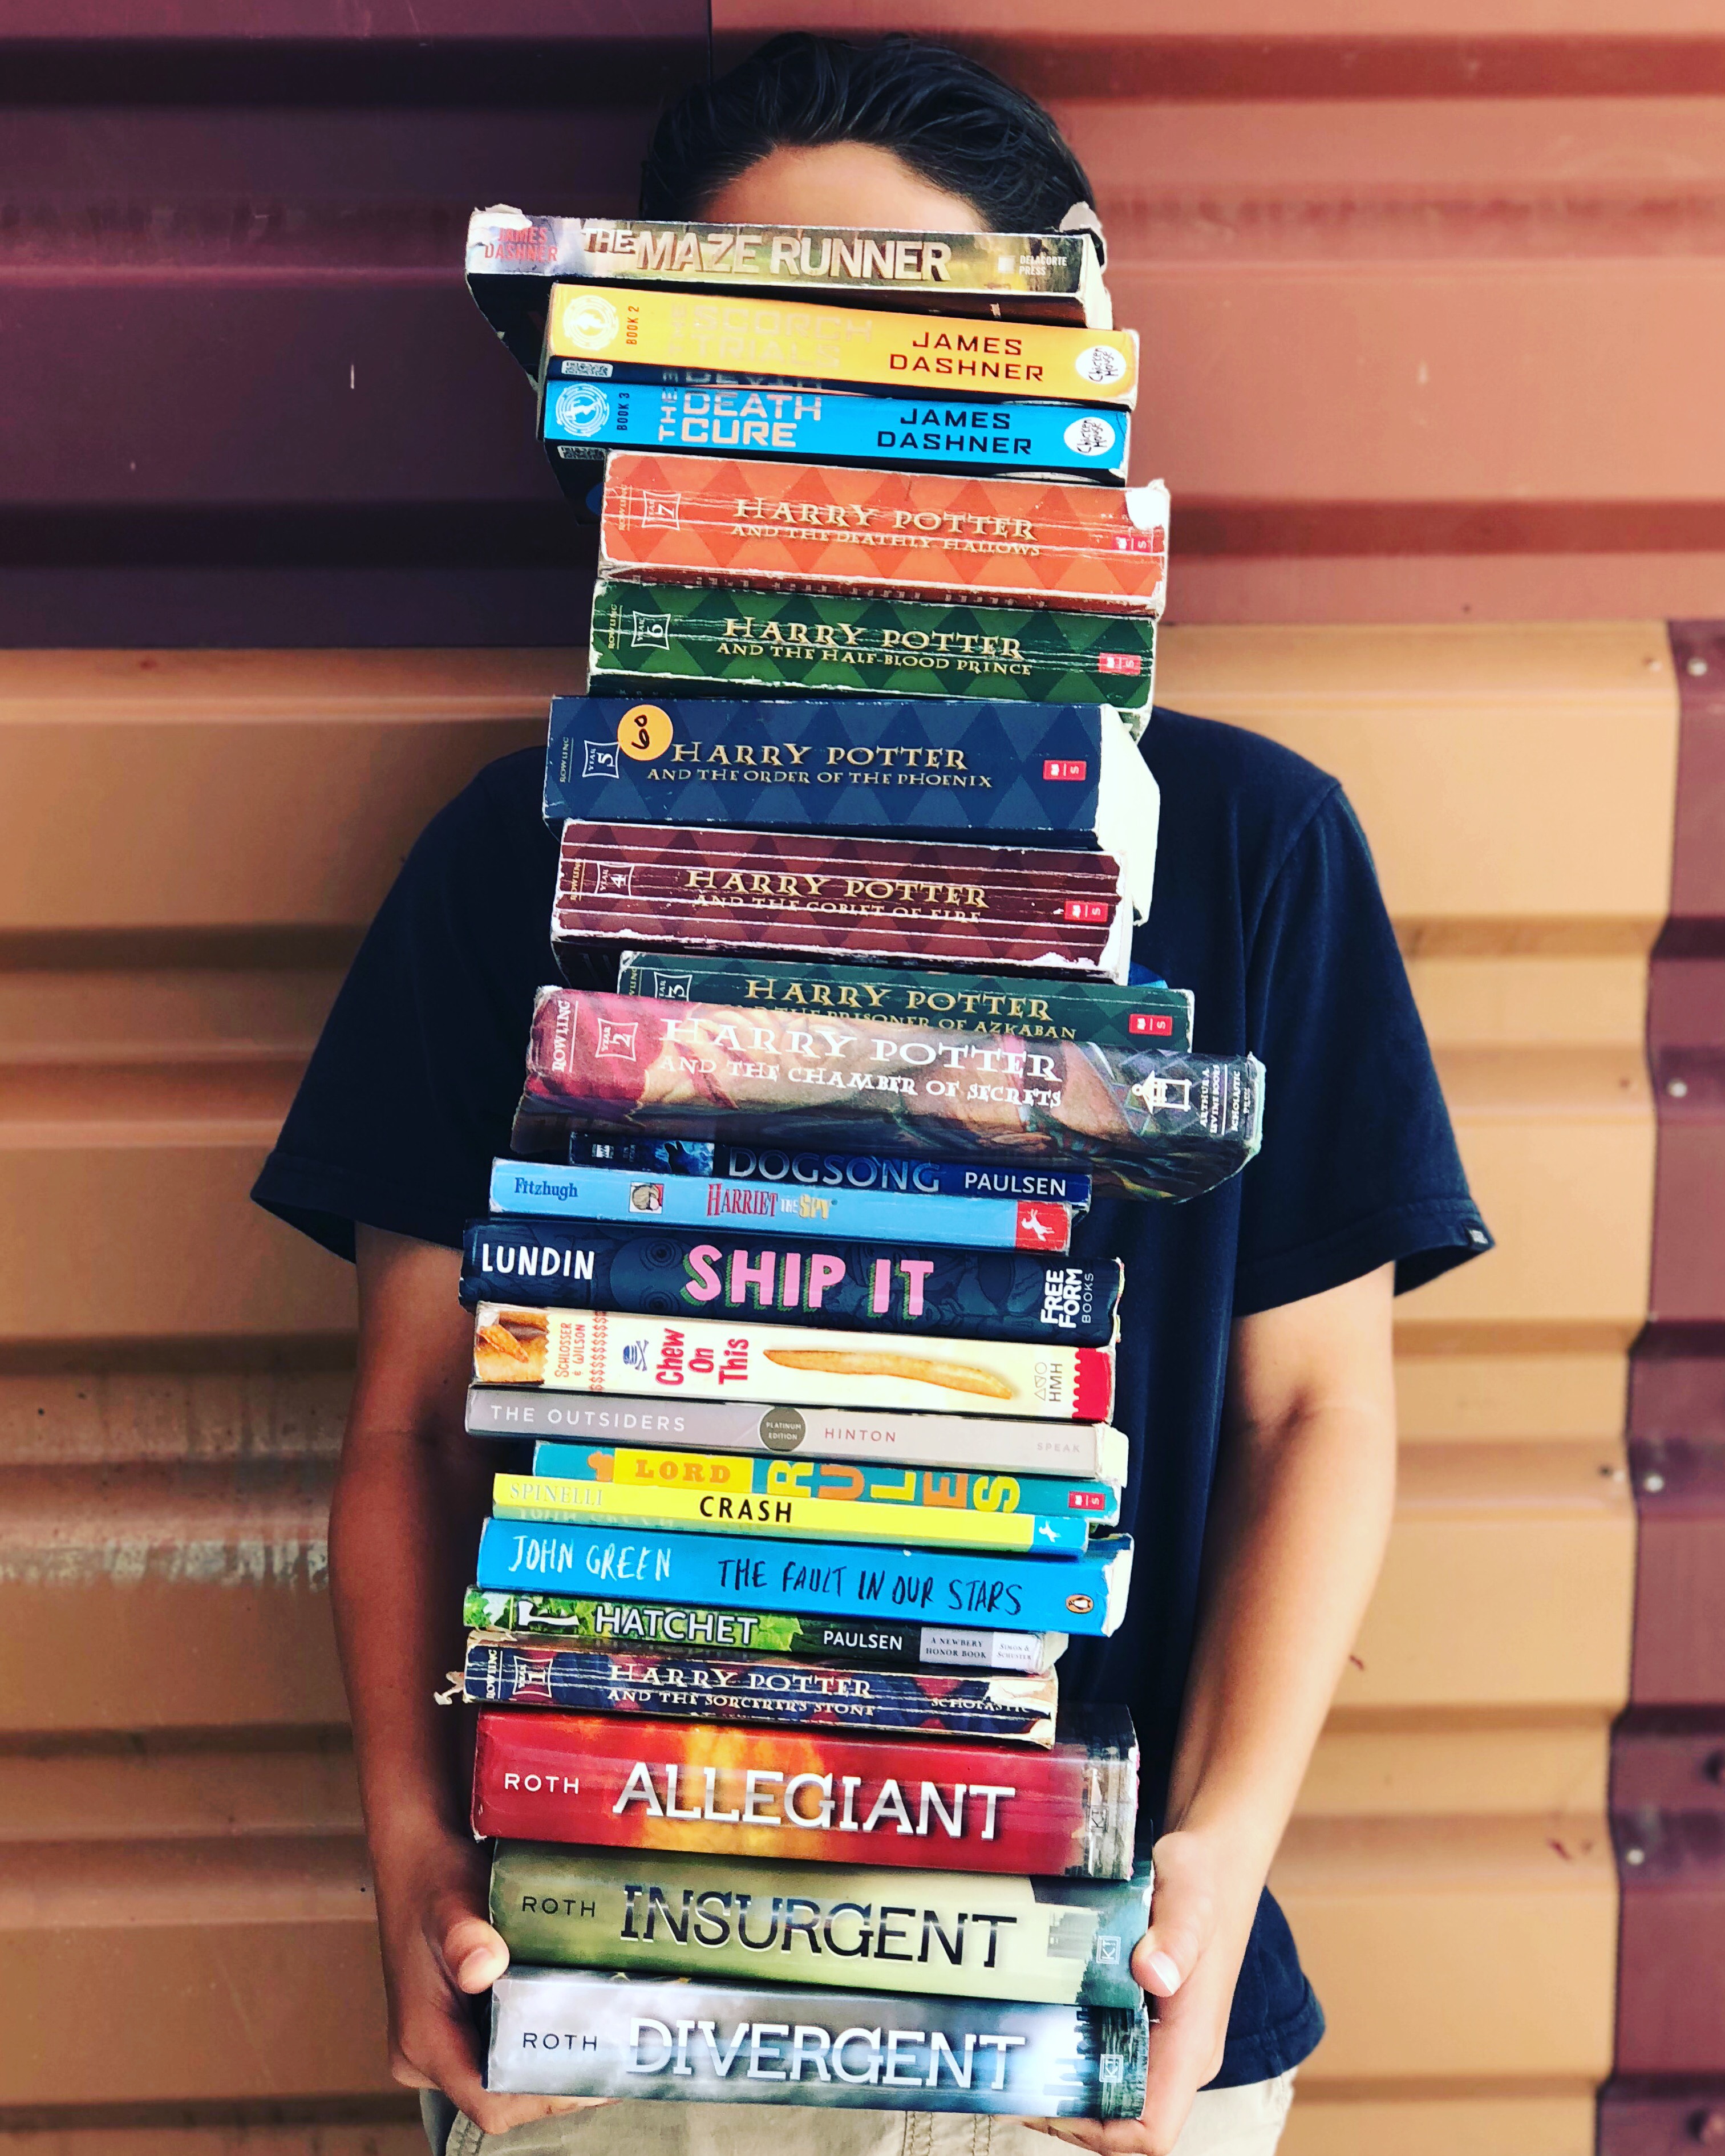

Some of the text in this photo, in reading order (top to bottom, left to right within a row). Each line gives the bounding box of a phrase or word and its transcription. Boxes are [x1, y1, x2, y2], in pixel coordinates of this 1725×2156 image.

[498, 226, 548, 244] JAMES
[485, 243, 558, 262] DASHNER
[581, 228, 952, 282] THE MAZE RUNNER
[1019, 255, 1068, 266] DELACORTE
[1019, 266, 1046, 275] PRESS
[626, 316, 639, 346] BOOK
[693, 305, 873, 343] SCORCH
[691, 333, 841, 368] TRIALS
[912, 332, 1022, 355] JAMES
[890, 354, 1043, 383] DASHNER
[617, 403, 629, 431] BOOK
[658, 387, 678, 441] THE
[682, 391, 821, 421] DEATH
[900, 408, 1010, 429] JAMES
[681, 416, 797, 448] CURE
[877, 431, 1031, 455] DASHNER
[618, 484, 627, 531] ROWLING
[655, 504, 674, 518] 7
[733, 498, 1037, 540] HARRY POTTER
[731, 525, 778, 537] AND
[787, 529, 829, 541] THE
[836, 533, 932, 549] DEATHLY
[608, 604, 617, 649] ROWLING
[647, 624, 663, 638] 6
[724, 617, 1026, 661] HARRY POTTER
[717, 643, 1032, 676] AND THE HALF-BLOOD PRINCE
[560, 737, 569, 783] ROWLING
[596, 752, 616, 767] 5
[671, 741, 968, 770] HARRY POTTER
[648, 768, 993, 788] AND THE ORDER OF THE PHOENIX
[610, 874, 626, 888] 4
[685, 869, 989, 909] HARRY POTTER
[694, 894, 744, 906] AND
[665, 984, 687, 998] 3
[745, 978, 1053, 1022] HARRY POTTER
[552, 999, 571, 1072] ROWLING
[602, 1027, 611, 1052] YEAR
[612, 1033, 633, 1048] 2
[939, 1018, 967, 1031] OF
[974, 1021, 1076, 1039] AZKABAN
[659, 1018, 1062, 1083] HARRY POTTER
[659, 1057, 1062, 1107] AND THE CHAMBER OF SECRETS
[1200, 1080, 1209, 1128] ARTHUR
[1210, 1096, 1219, 1133] LEVINE
[1231, 1071, 1241, 1132] SCHOLASTIC
[515, 1177, 578, 1200] Fitzhugh
[729, 1148, 1066, 1197] DOGSONG PAULSEN
[707, 1184, 831, 1219] HARRIET THE SPY
[482, 1243, 594, 1279] LUNDIN
[681, 1245, 934, 1320] SHIP IT
[1040, 1270, 1063, 1324] FREE
[1059, 1269, 1083, 1328] FORM
[1082, 1272, 1094, 1323] BOOKS
[554, 1323, 572, 1377] SCHLOSSER
[572, 1324, 585, 1364] WILSON
[655, 1328, 685, 1385] Chew
[689, 1348, 714, 1373] On
[719, 1338, 749, 1385] This
[1048, 1363, 1063, 1403] HMH
[491, 1405, 685, 1432] THE OUTSIDERS
[824, 1428, 896, 1442] HINTON
[1036, 1443, 1080, 1453] SPEAK
[635, 1460, 731, 1484] LORD
[767, 1460, 1020, 1513] RULES
[509, 1482, 603, 1506] SPINELLI
[699, 1496, 792, 1523] CRASH
[508, 1535, 671, 1581] JOHN GREEN
[718, 1558, 1023, 1616] THE FAULT IN OUR STARS
[593, 1605, 759, 1645] HATCHET
[824, 1630, 902, 1651] PAULSEN
[926, 1648, 958, 1656] HONOR
[940, 1638, 983, 1648] NEWBERY
[486, 1649, 497, 1700] ROWLING
[608, 1663, 874, 1699] HARRY POTTER
[608, 1689, 651, 1703] AND
[659, 1691, 698, 1705] THE
[814, 1701, 878, 1716] STONE
[505, 1774, 580, 1794] ROTH
[612, 1762, 1015, 1841] ALLEGIANT
[521, 1896, 596, 1918] ROTH
[620, 1884, 1017, 1968] INSURGENT
[523, 2033, 597, 2052] ROTH
[626, 2017, 1026, 2090] DIVERGENT
